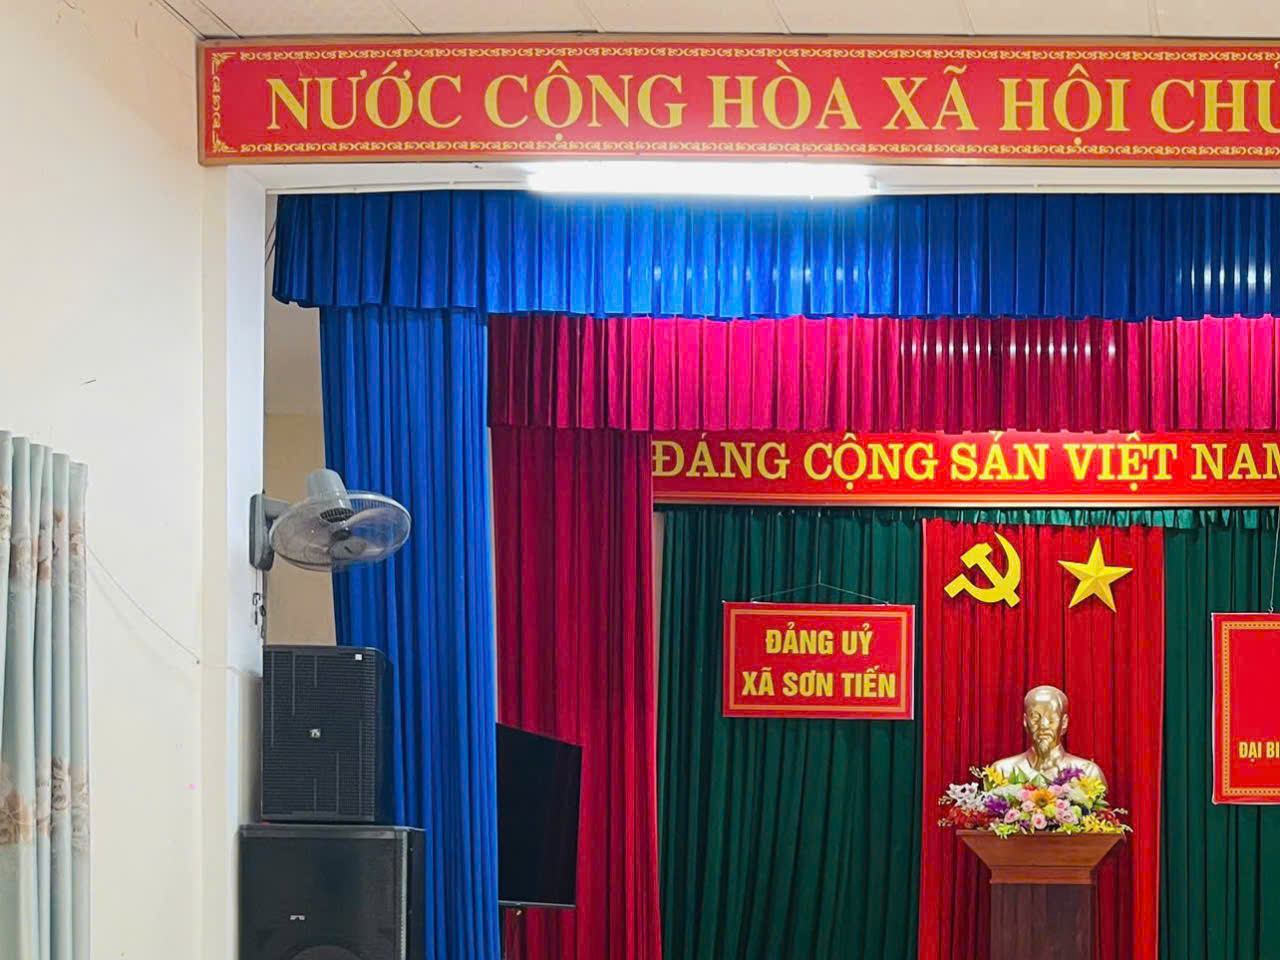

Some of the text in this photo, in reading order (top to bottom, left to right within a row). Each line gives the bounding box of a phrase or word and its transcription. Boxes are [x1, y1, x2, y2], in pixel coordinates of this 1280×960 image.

[265, 61, 463, 130] NƯỚC
[483, 60, 686, 142] CỘNG
[707, 59, 862, 131] HÒA
[882, 65, 980, 131] XÃ
[1000, 63, 1131, 146] HỘI
[804, 433, 938, 490] CỘNG
[1063, 432, 1177, 491] VIỆT
[765, 621, 873, 656] ĐẢNG UỶ
[741, 665, 896, 699] XÃ SƠN TIẾN
[1238, 741, 1262, 762] ĐẠI
